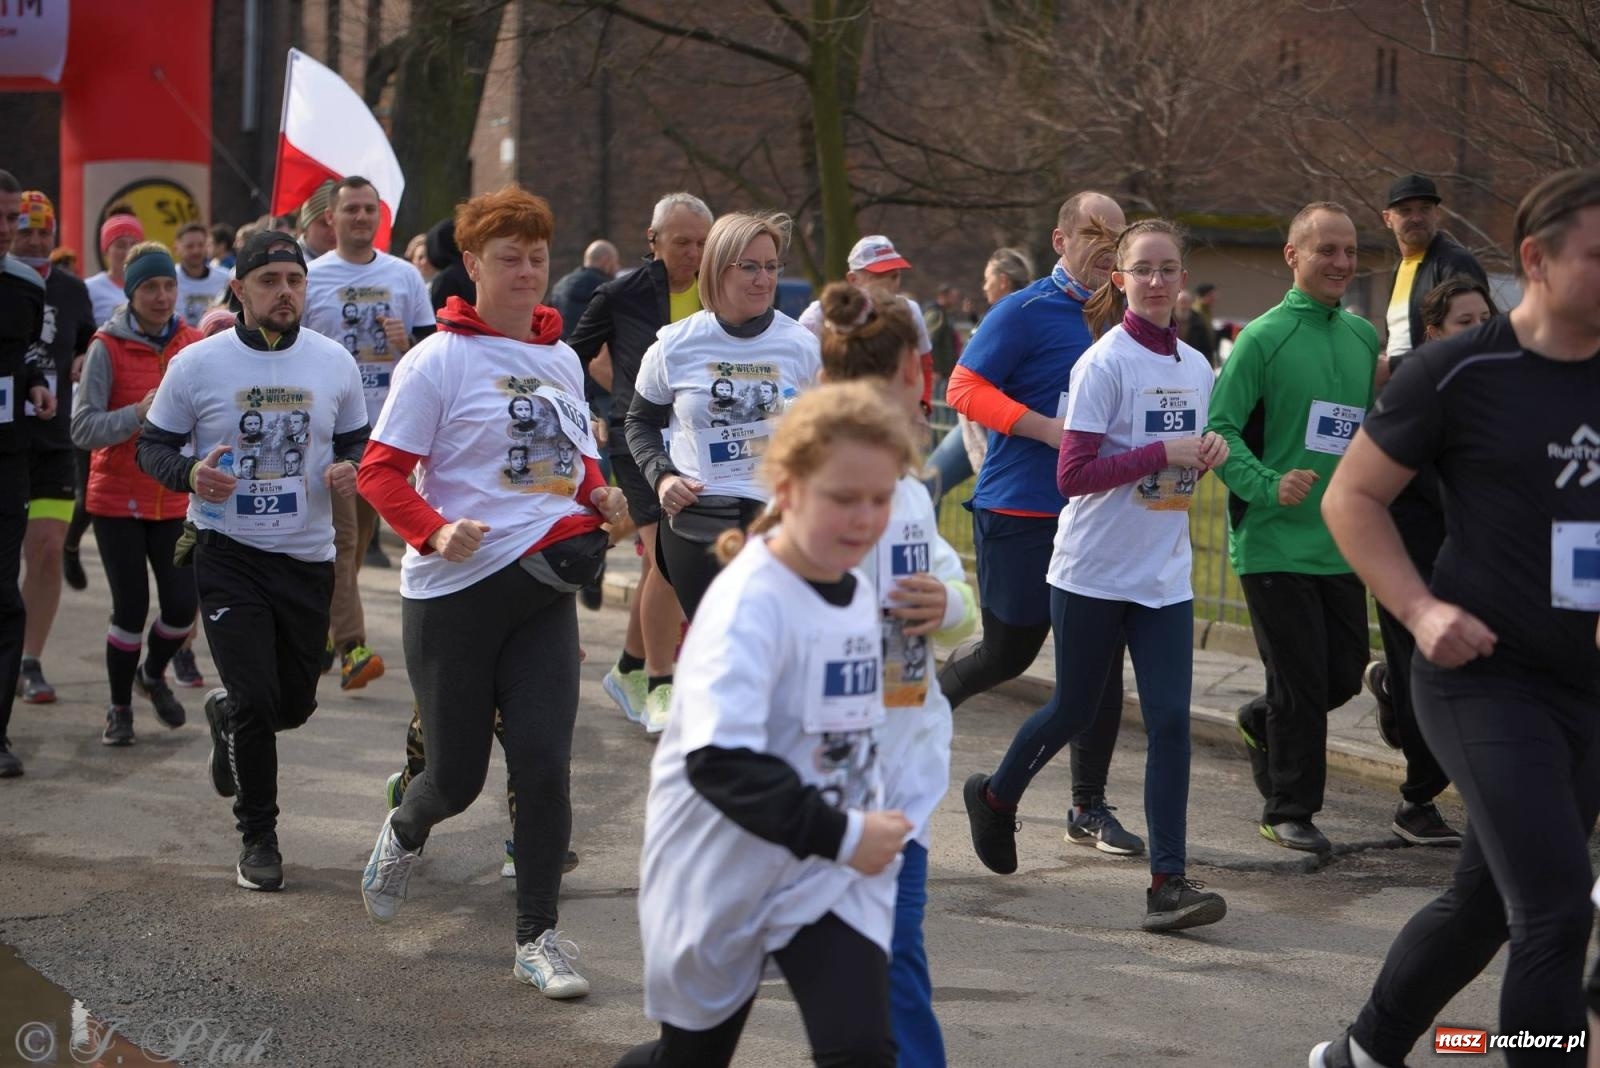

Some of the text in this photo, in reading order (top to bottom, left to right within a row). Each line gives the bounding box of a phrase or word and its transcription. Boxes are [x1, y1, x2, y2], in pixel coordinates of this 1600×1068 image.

[1163, 411, 1184, 431] 95
[1332, 419, 1353, 438] 39
[727, 439, 752, 460] 94
[253, 496, 280, 514] 92
[840, 661, 875, 694] 117
